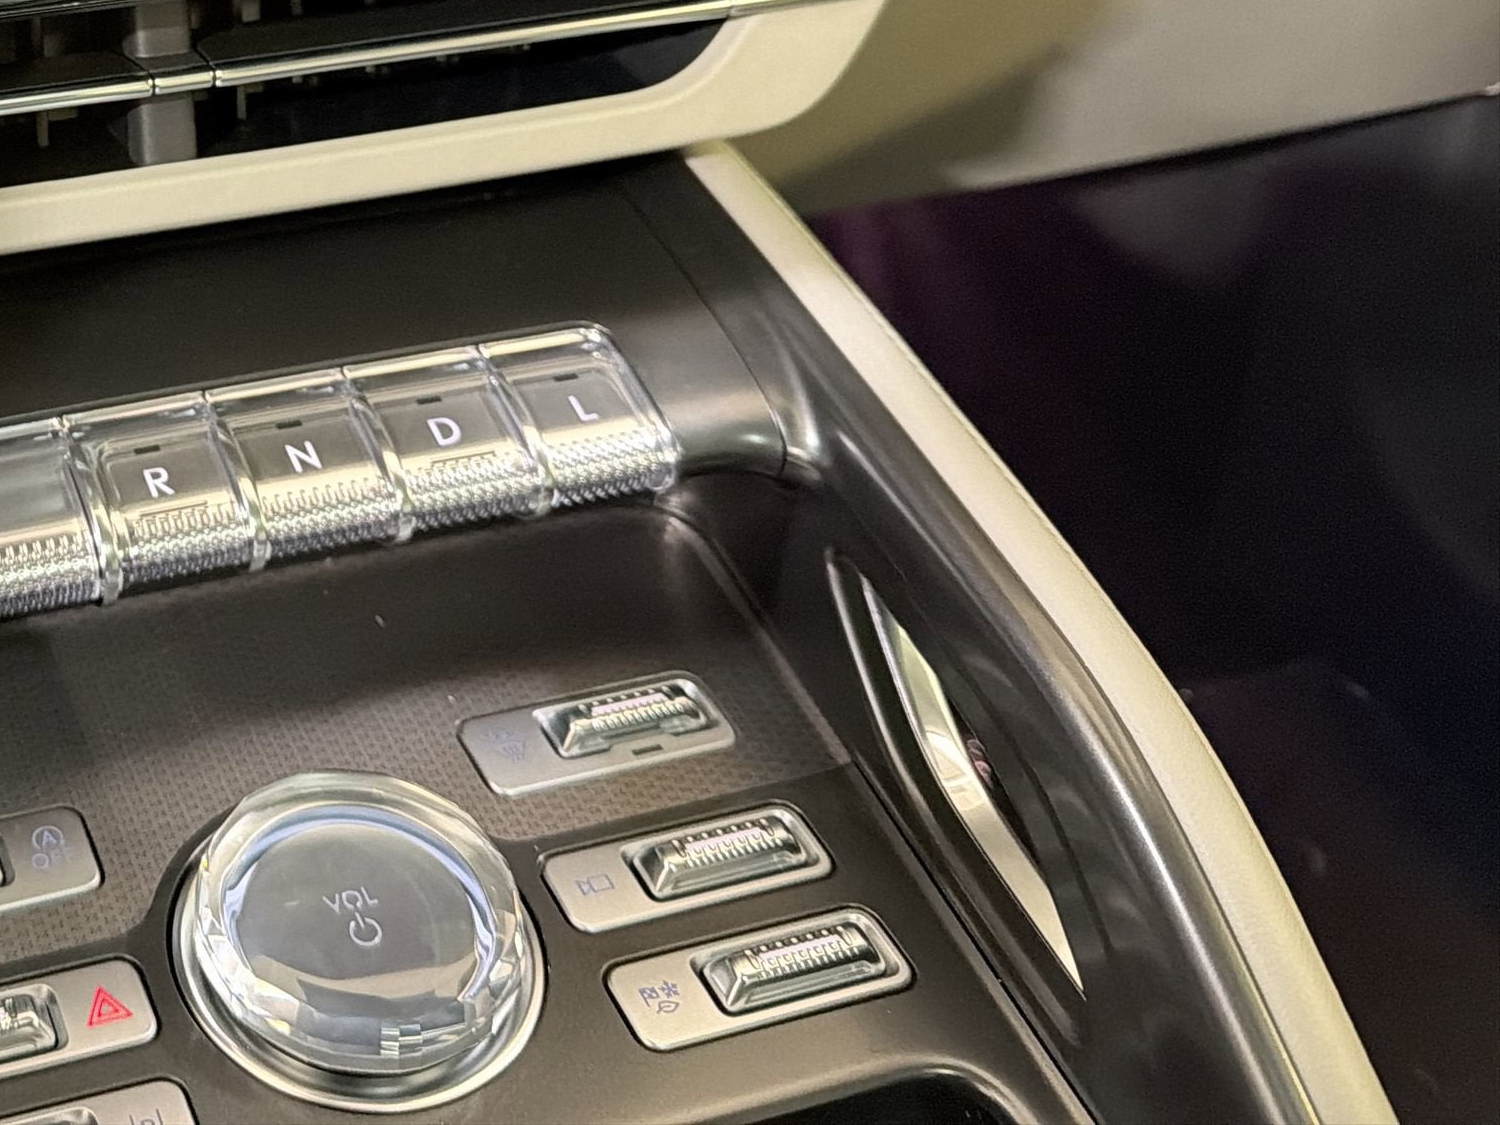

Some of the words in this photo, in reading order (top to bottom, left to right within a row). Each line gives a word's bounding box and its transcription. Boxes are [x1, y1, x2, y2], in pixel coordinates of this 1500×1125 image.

[143, 467, 175, 498] R
[284, 440, 323, 473] N
[427, 417, 462, 447] D
[568, 395, 599, 422] L
[322, 886, 379, 914] VOL
